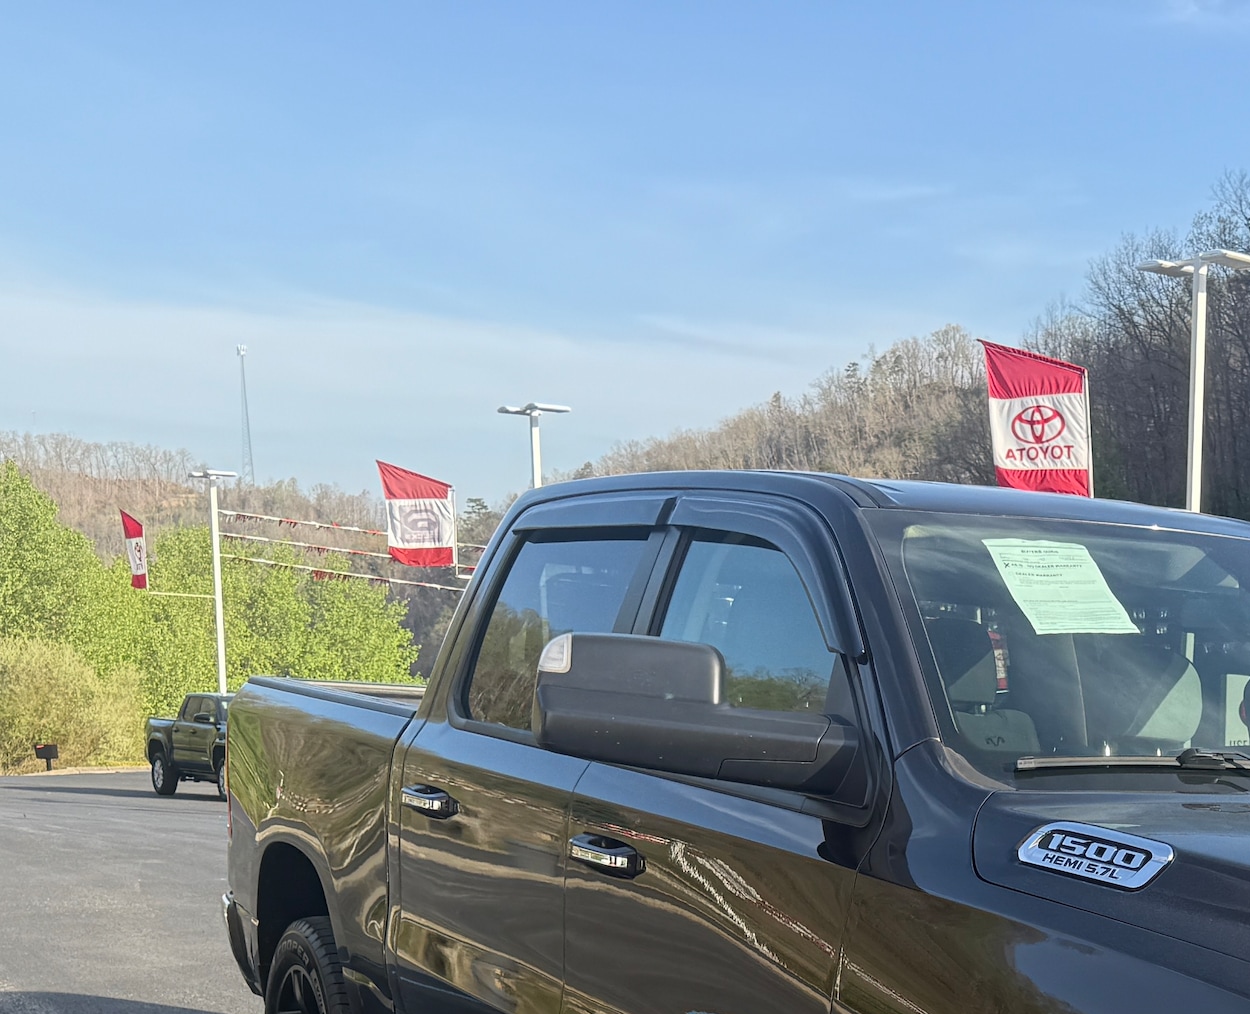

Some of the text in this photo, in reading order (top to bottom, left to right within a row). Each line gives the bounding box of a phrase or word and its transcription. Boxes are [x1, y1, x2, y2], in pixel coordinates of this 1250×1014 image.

[1042, 852, 1120, 880] HEMI 5.7L
[1047, 833, 1146, 869] 1500
